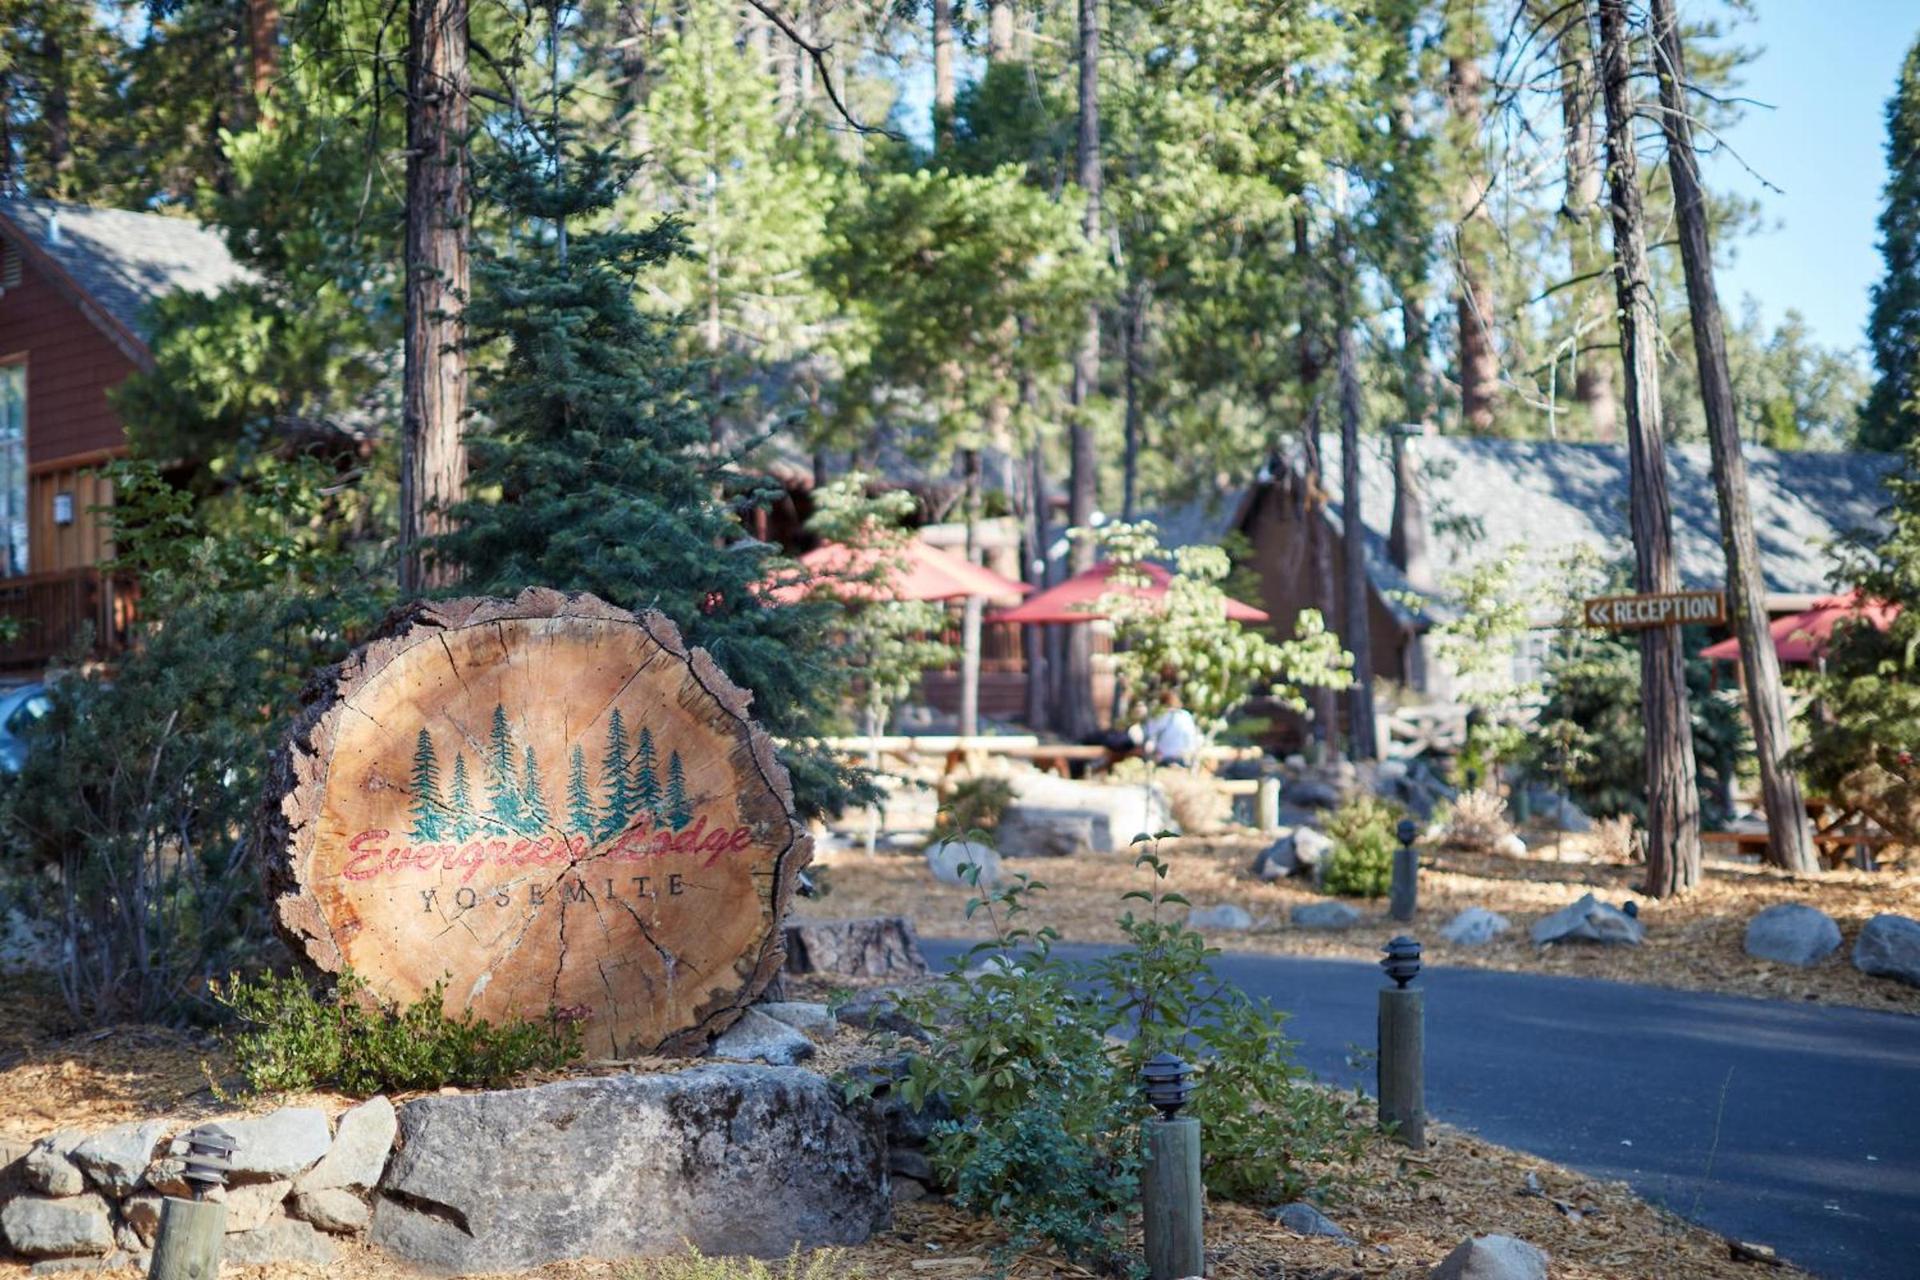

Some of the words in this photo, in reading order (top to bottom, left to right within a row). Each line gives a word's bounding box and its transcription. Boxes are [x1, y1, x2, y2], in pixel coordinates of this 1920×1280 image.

[1613, 595, 1718, 624] RECEPTION
[343, 828, 588, 884] Evergreen
[606, 810, 751, 869] Lodge
[420, 873, 685, 913] YOSEMITE
